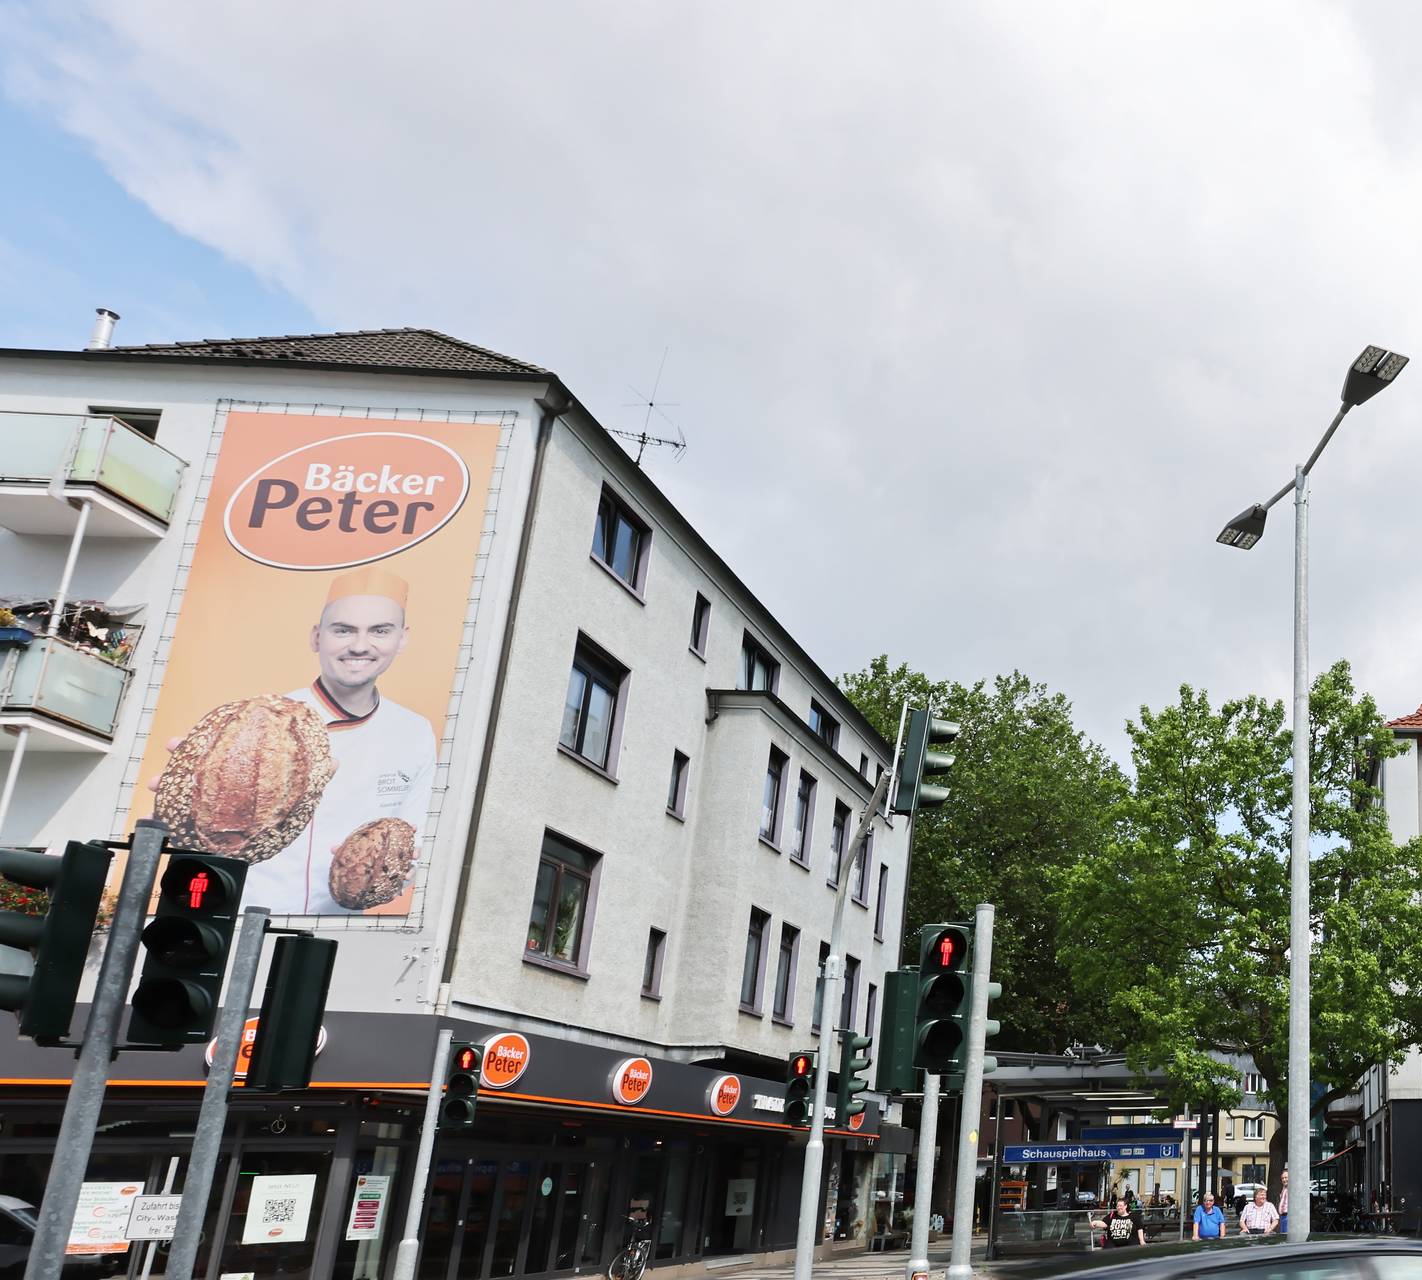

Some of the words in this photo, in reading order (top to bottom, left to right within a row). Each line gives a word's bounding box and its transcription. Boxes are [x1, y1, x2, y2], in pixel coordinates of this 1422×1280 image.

[304, 463, 445, 495] Bäcker
[248, 478, 435, 535] Peter
[497, 1045, 525, 1059] Bäcker
[486, 1051, 522, 1073] Peter
[629, 1068, 649, 1080] Bäcker
[622, 1073, 647, 1092] Peter
[723, 1085, 738, 1094] Bäcker
[717, 1089, 736, 1105] Peter
[1022, 1148, 1107, 1160] Schauspielhaus
[141, 1202, 168, 1211] Zufahrt
